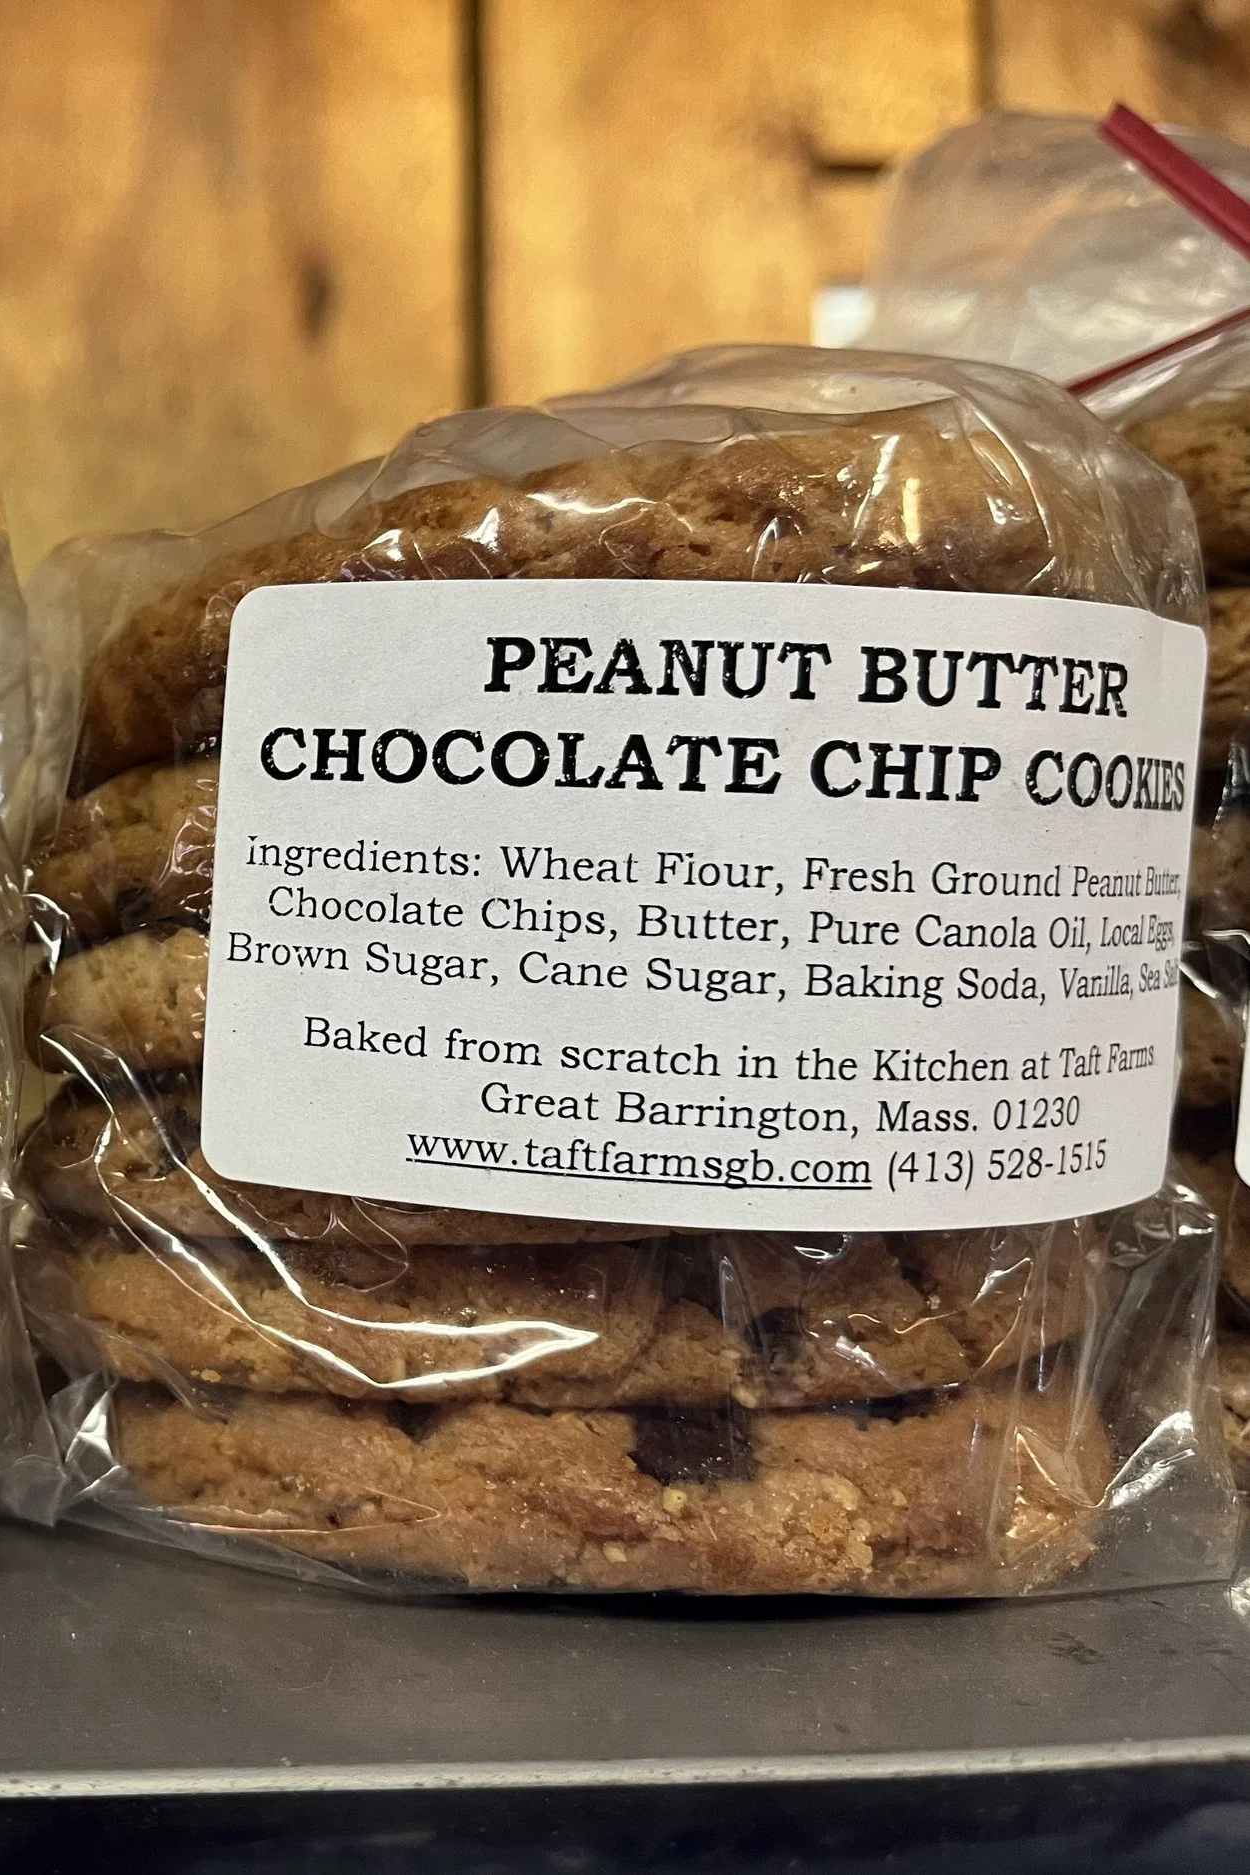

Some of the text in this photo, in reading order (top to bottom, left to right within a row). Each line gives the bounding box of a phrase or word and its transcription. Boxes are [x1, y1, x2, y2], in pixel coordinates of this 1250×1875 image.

[483, 636, 1129, 719] PEANUT BUTTER
[259, 726, 1185, 813] CHOCOLATE CHIP COOKIES
[245, 835, 481, 877] Ingredients:
[499, 845, 639, 884] Wheat
[801, 857, 916, 894] Fresh
[931, 861, 1062, 898] Ground
[1070, 865, 1143, 898] Peanut
[1144, 865, 1180, 901] Butter,
[268, 885, 464, 928] Chocolate
[480, 897, 618, 943] Chips,
[636, 904, 790, 950] Butter,
[807, 910, 900, 946] Pure
[915, 913, 1038, 949] Canola
[1048, 915, 1092, 956] Oil,
[1099, 914, 1145, 948] Local
[226, 931, 350, 971] Brown
[365, 941, 499, 988] Sugar,
[518, 950, 629, 989] Cane
[645, 957, 786, 1003] Sugar,
[803, 963, 945, 1009] Baking
[956, 966, 1046, 1007] Soda,
[1059, 964, 1134, 1001] Vanilla,
[1138, 962, 1161, 994] Sea
[303, 1015, 429, 1058] Baked
[444, 1027, 543, 1067] from
[560, 1043, 722, 1077] scratch
[736, 1044, 779, 1079] in
[794, 1047, 858, 1082] the
[871, 1048, 1010, 1083] Kitchen
[1020, 1051, 1051, 1081] at
[1058, 1044, 1102, 1079] Taft
[480, 1081, 1080, 1140] Great Barrington, Mass. 01230
[405, 1133, 1107, 1194] www.taftfarmsgb.com (413) 528-1515
